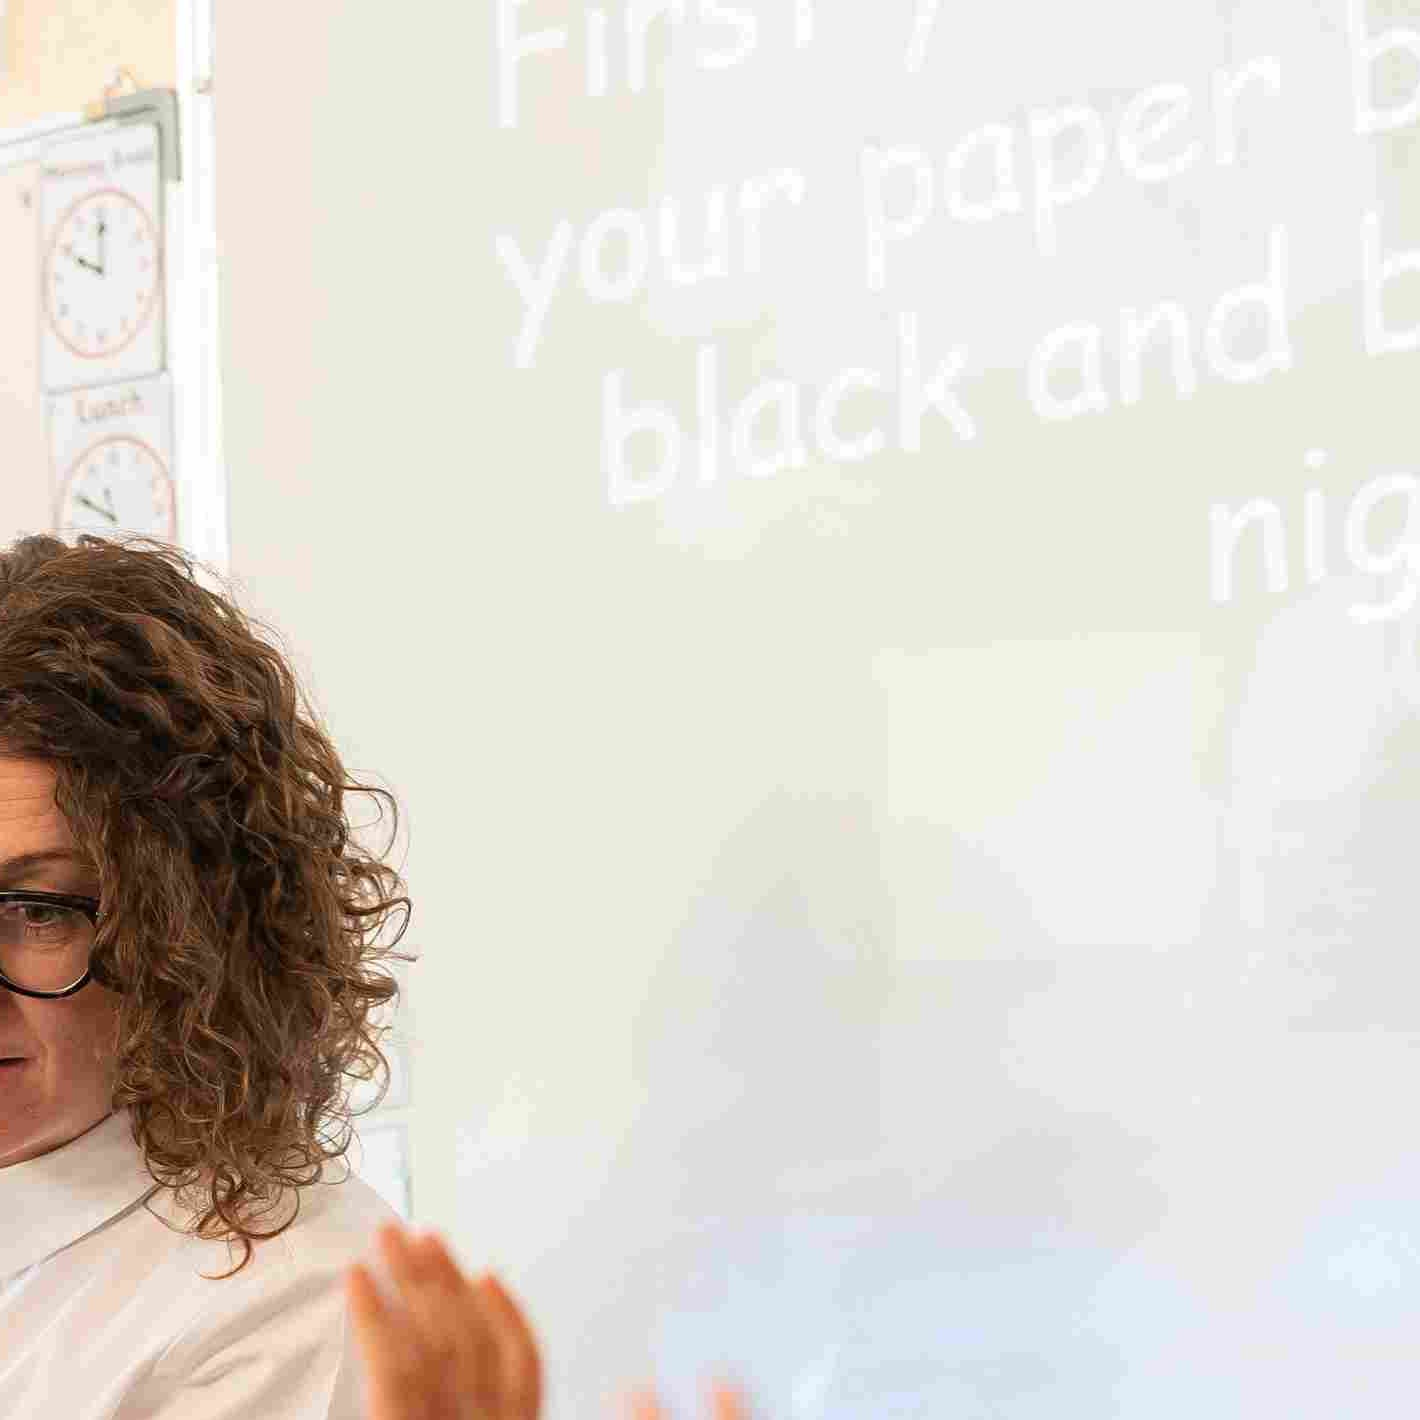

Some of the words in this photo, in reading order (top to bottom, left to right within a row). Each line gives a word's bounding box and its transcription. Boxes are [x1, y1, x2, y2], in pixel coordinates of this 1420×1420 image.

[494, 165, 808, 370] your
[861, 54, 1284, 292] paper
[601, 311, 978, 510] black
[1027, 221, 1294, 422] and
